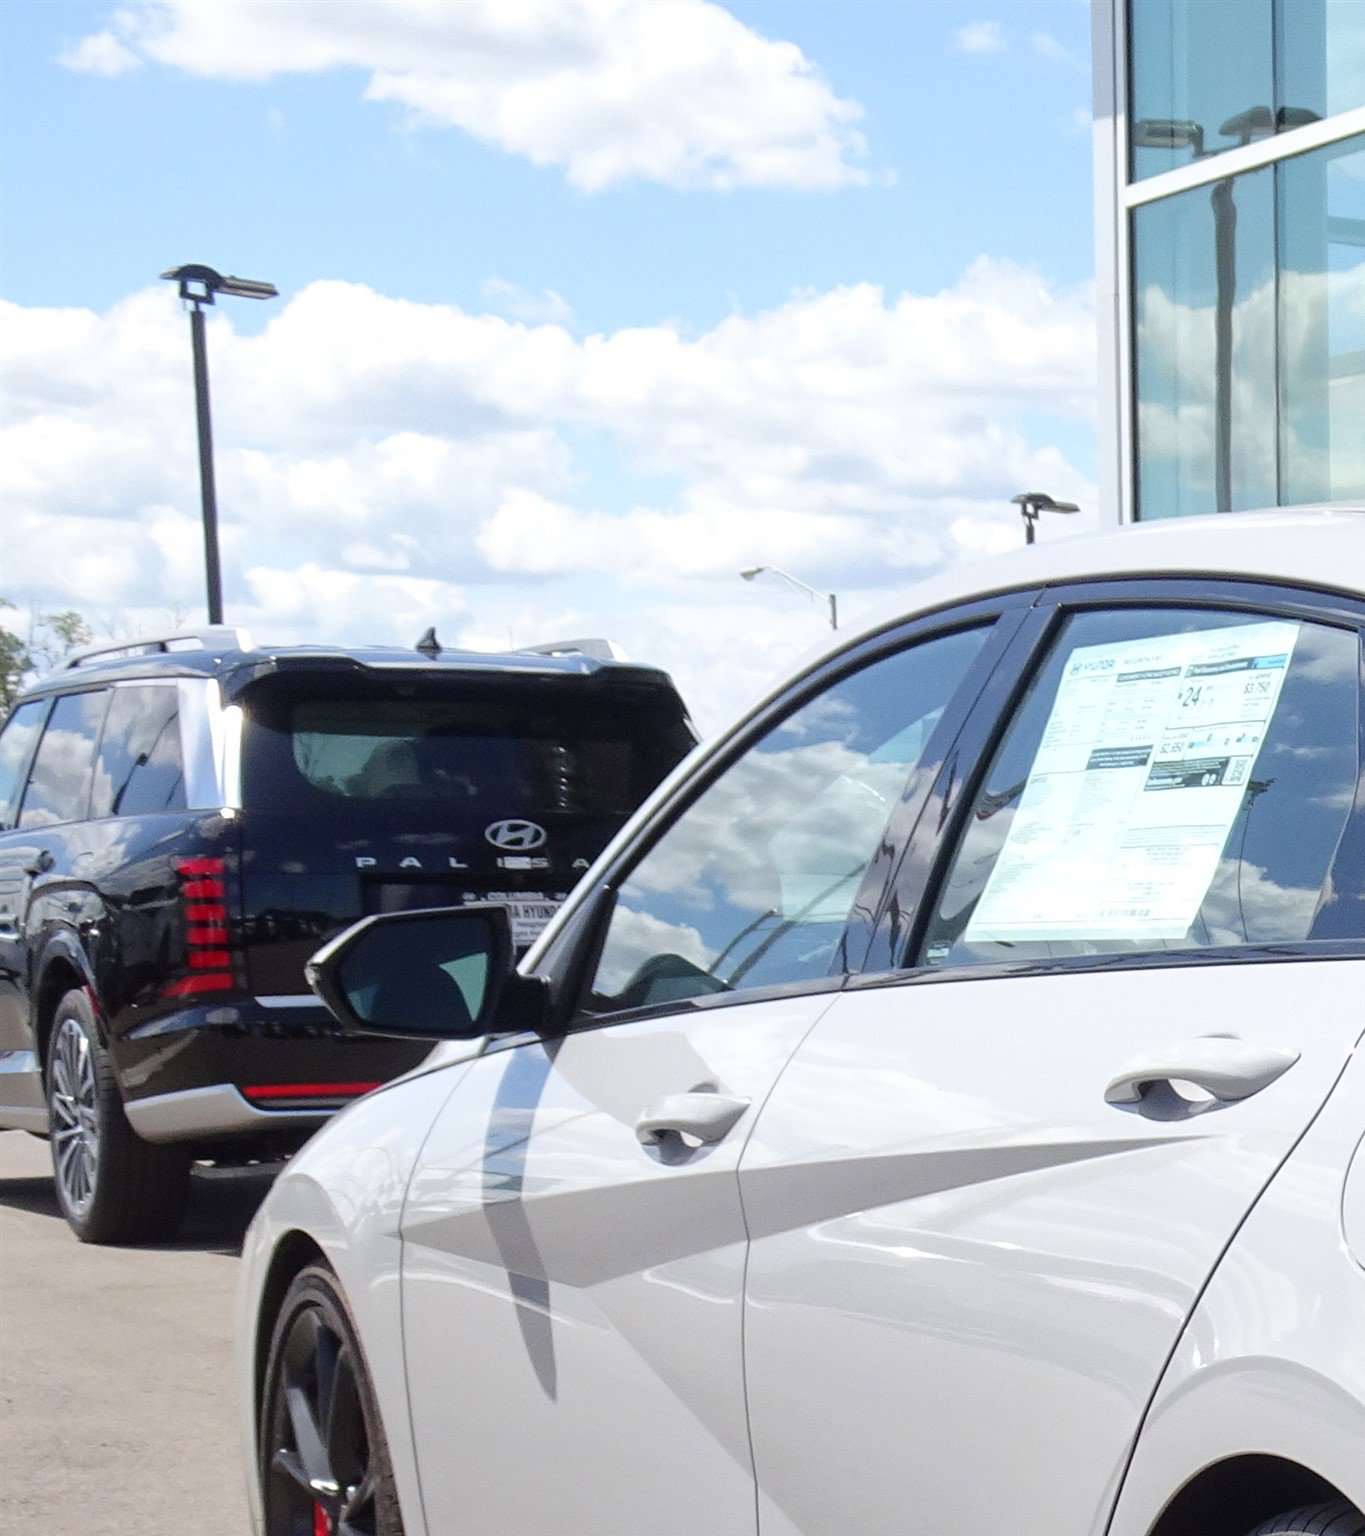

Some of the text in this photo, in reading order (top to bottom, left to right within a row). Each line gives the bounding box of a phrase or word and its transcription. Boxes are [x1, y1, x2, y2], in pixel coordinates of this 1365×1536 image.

[1182, 686, 1202, 707] 24
[356, 856, 590, 870] PALISA
[523, 904, 560, 919] HYUND
